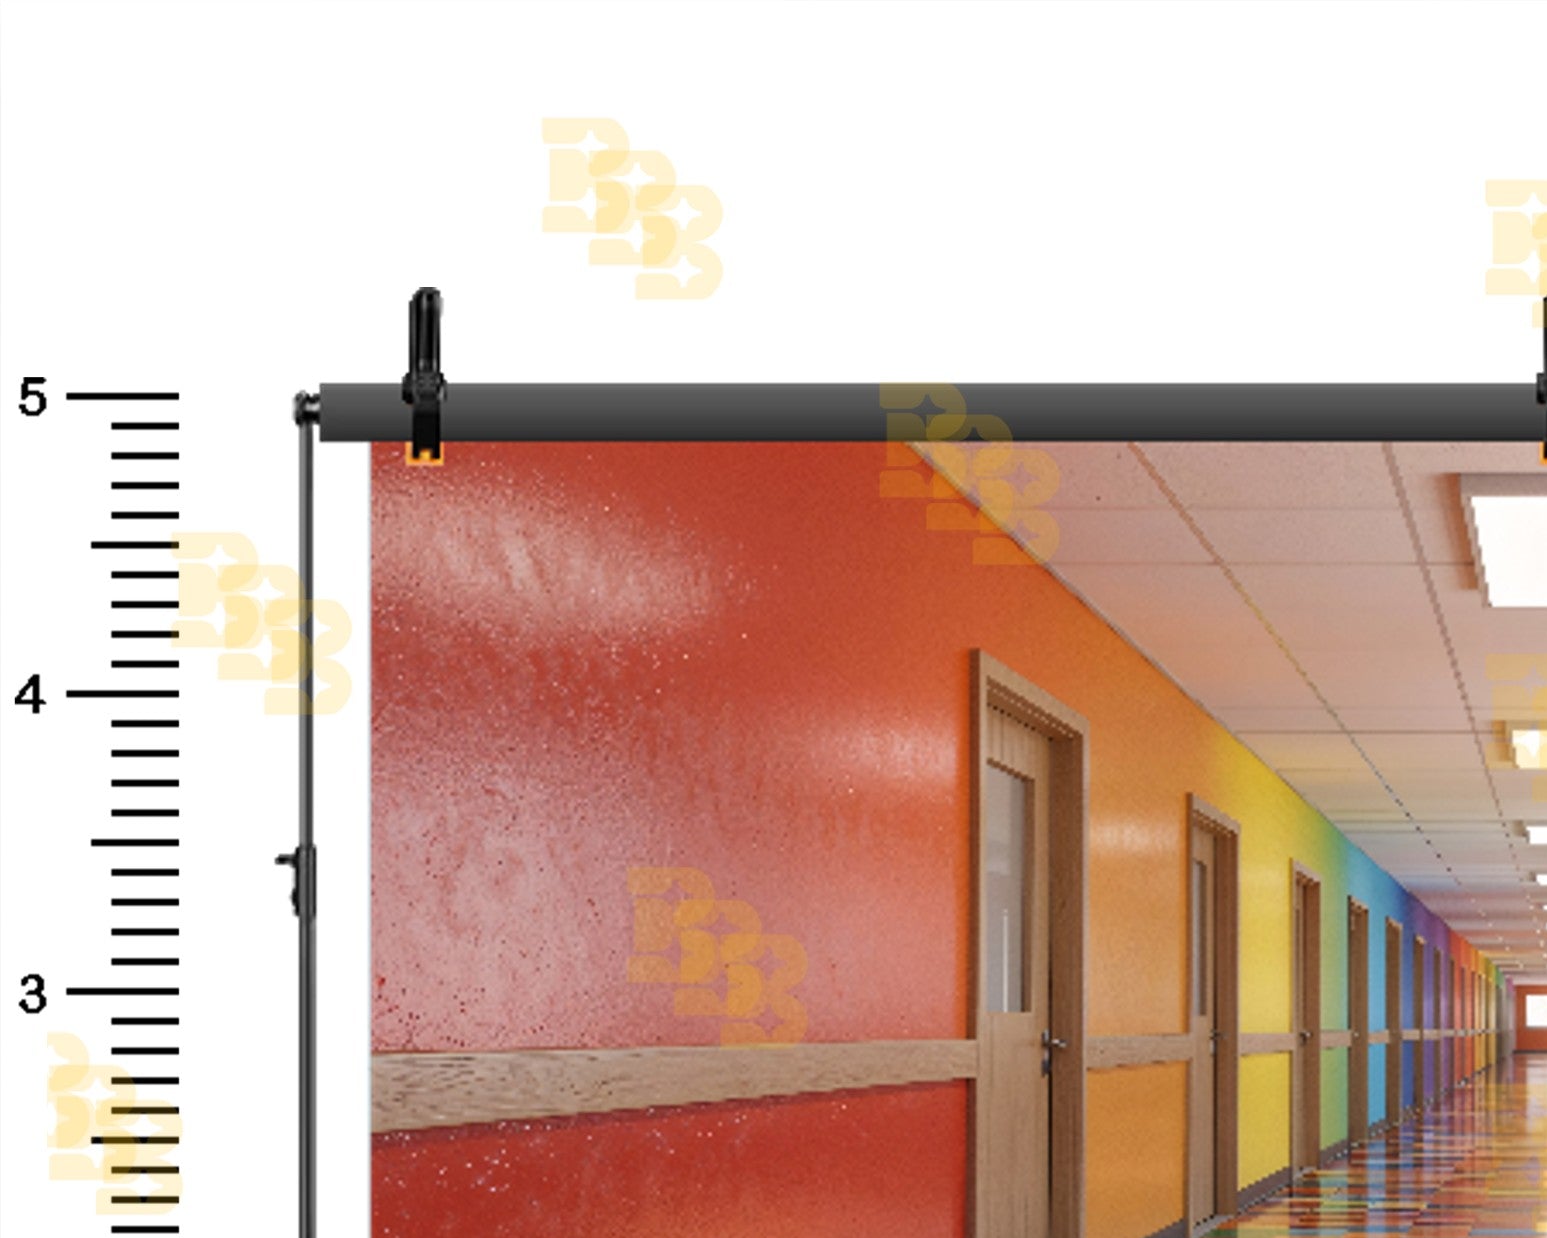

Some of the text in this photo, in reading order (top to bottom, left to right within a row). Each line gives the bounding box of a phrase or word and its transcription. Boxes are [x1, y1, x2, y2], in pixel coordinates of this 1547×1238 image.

[19, 377, 47, 417] 5
[14, 674, 47, 714] 4
[19, 974, 47, 1014] 3
